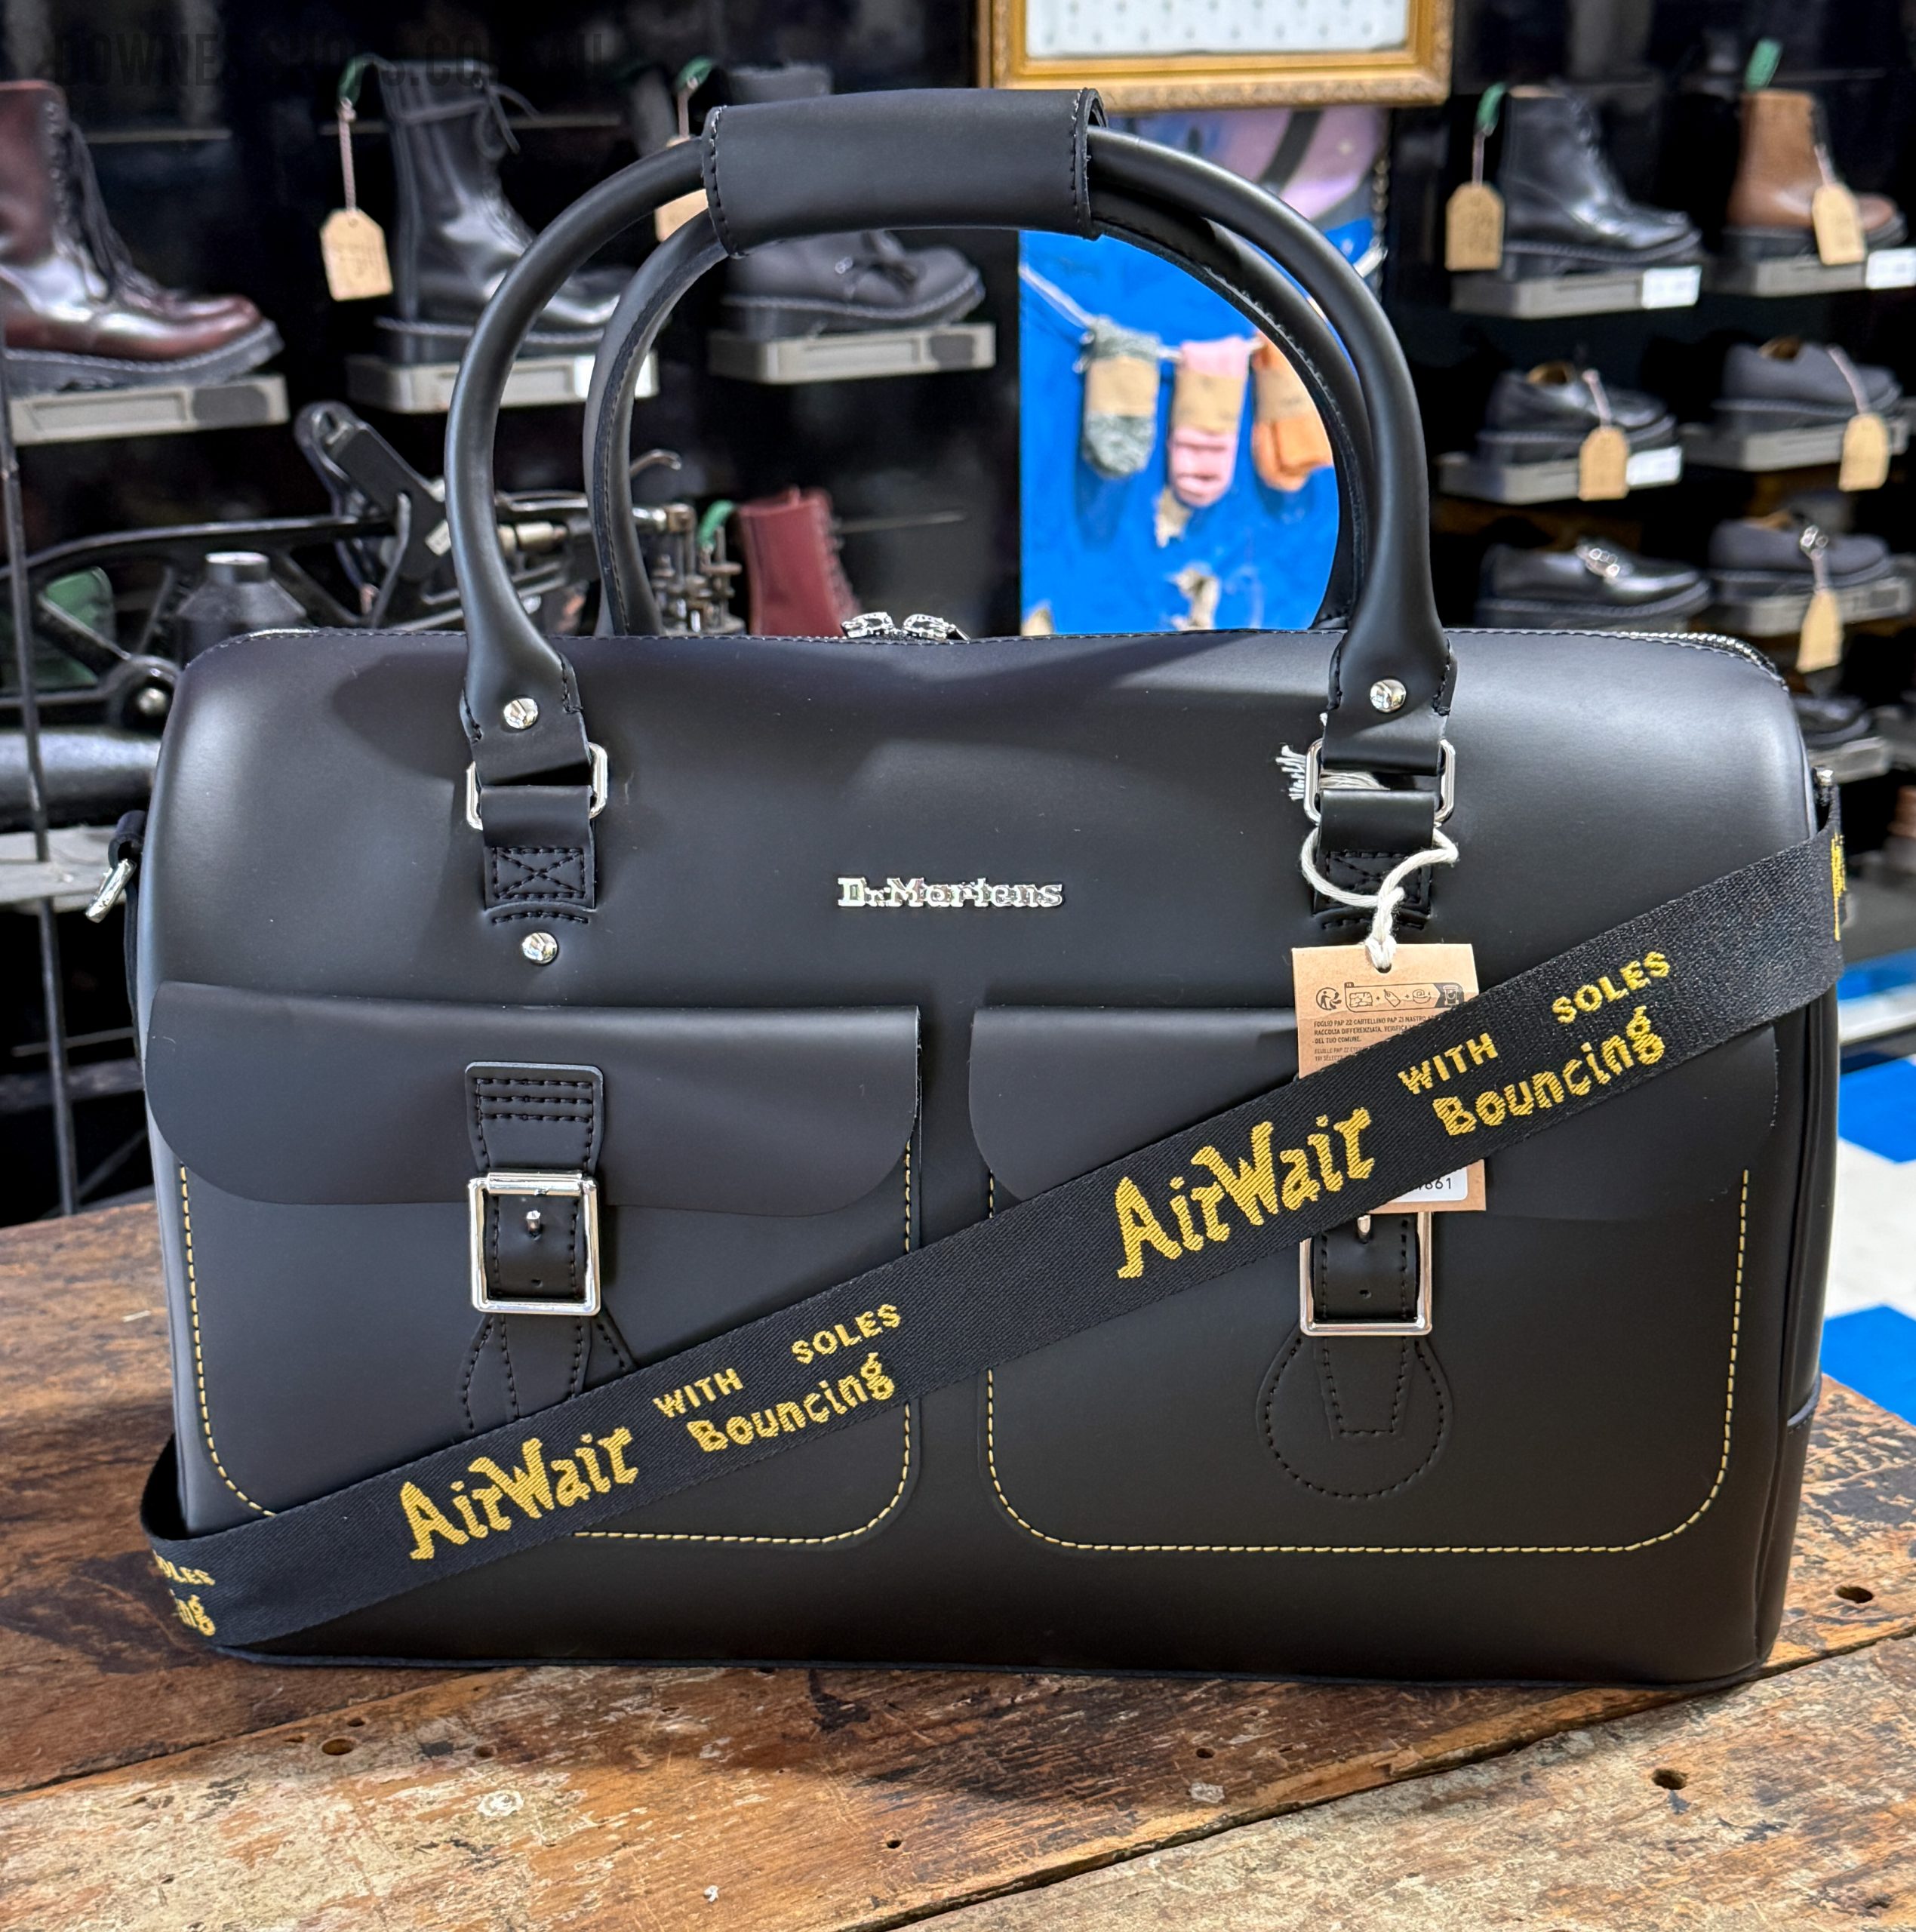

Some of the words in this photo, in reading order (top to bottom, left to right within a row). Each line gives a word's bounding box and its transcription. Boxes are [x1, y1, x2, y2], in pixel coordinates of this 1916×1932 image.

[1398, 1032, 1499, 1094] WITH
[1552, 950, 1671, 1025] SOLES
[1433, 1005, 1665, 1137] Bouncing
[1115, 1107, 1375, 1278] AirWair
[652, 1367, 744, 1419] WITH
[791, 1303, 902, 1364] SOLES
[686, 1352, 896, 1453] Bouncing
[400, 1426, 640, 1561] AirWair
